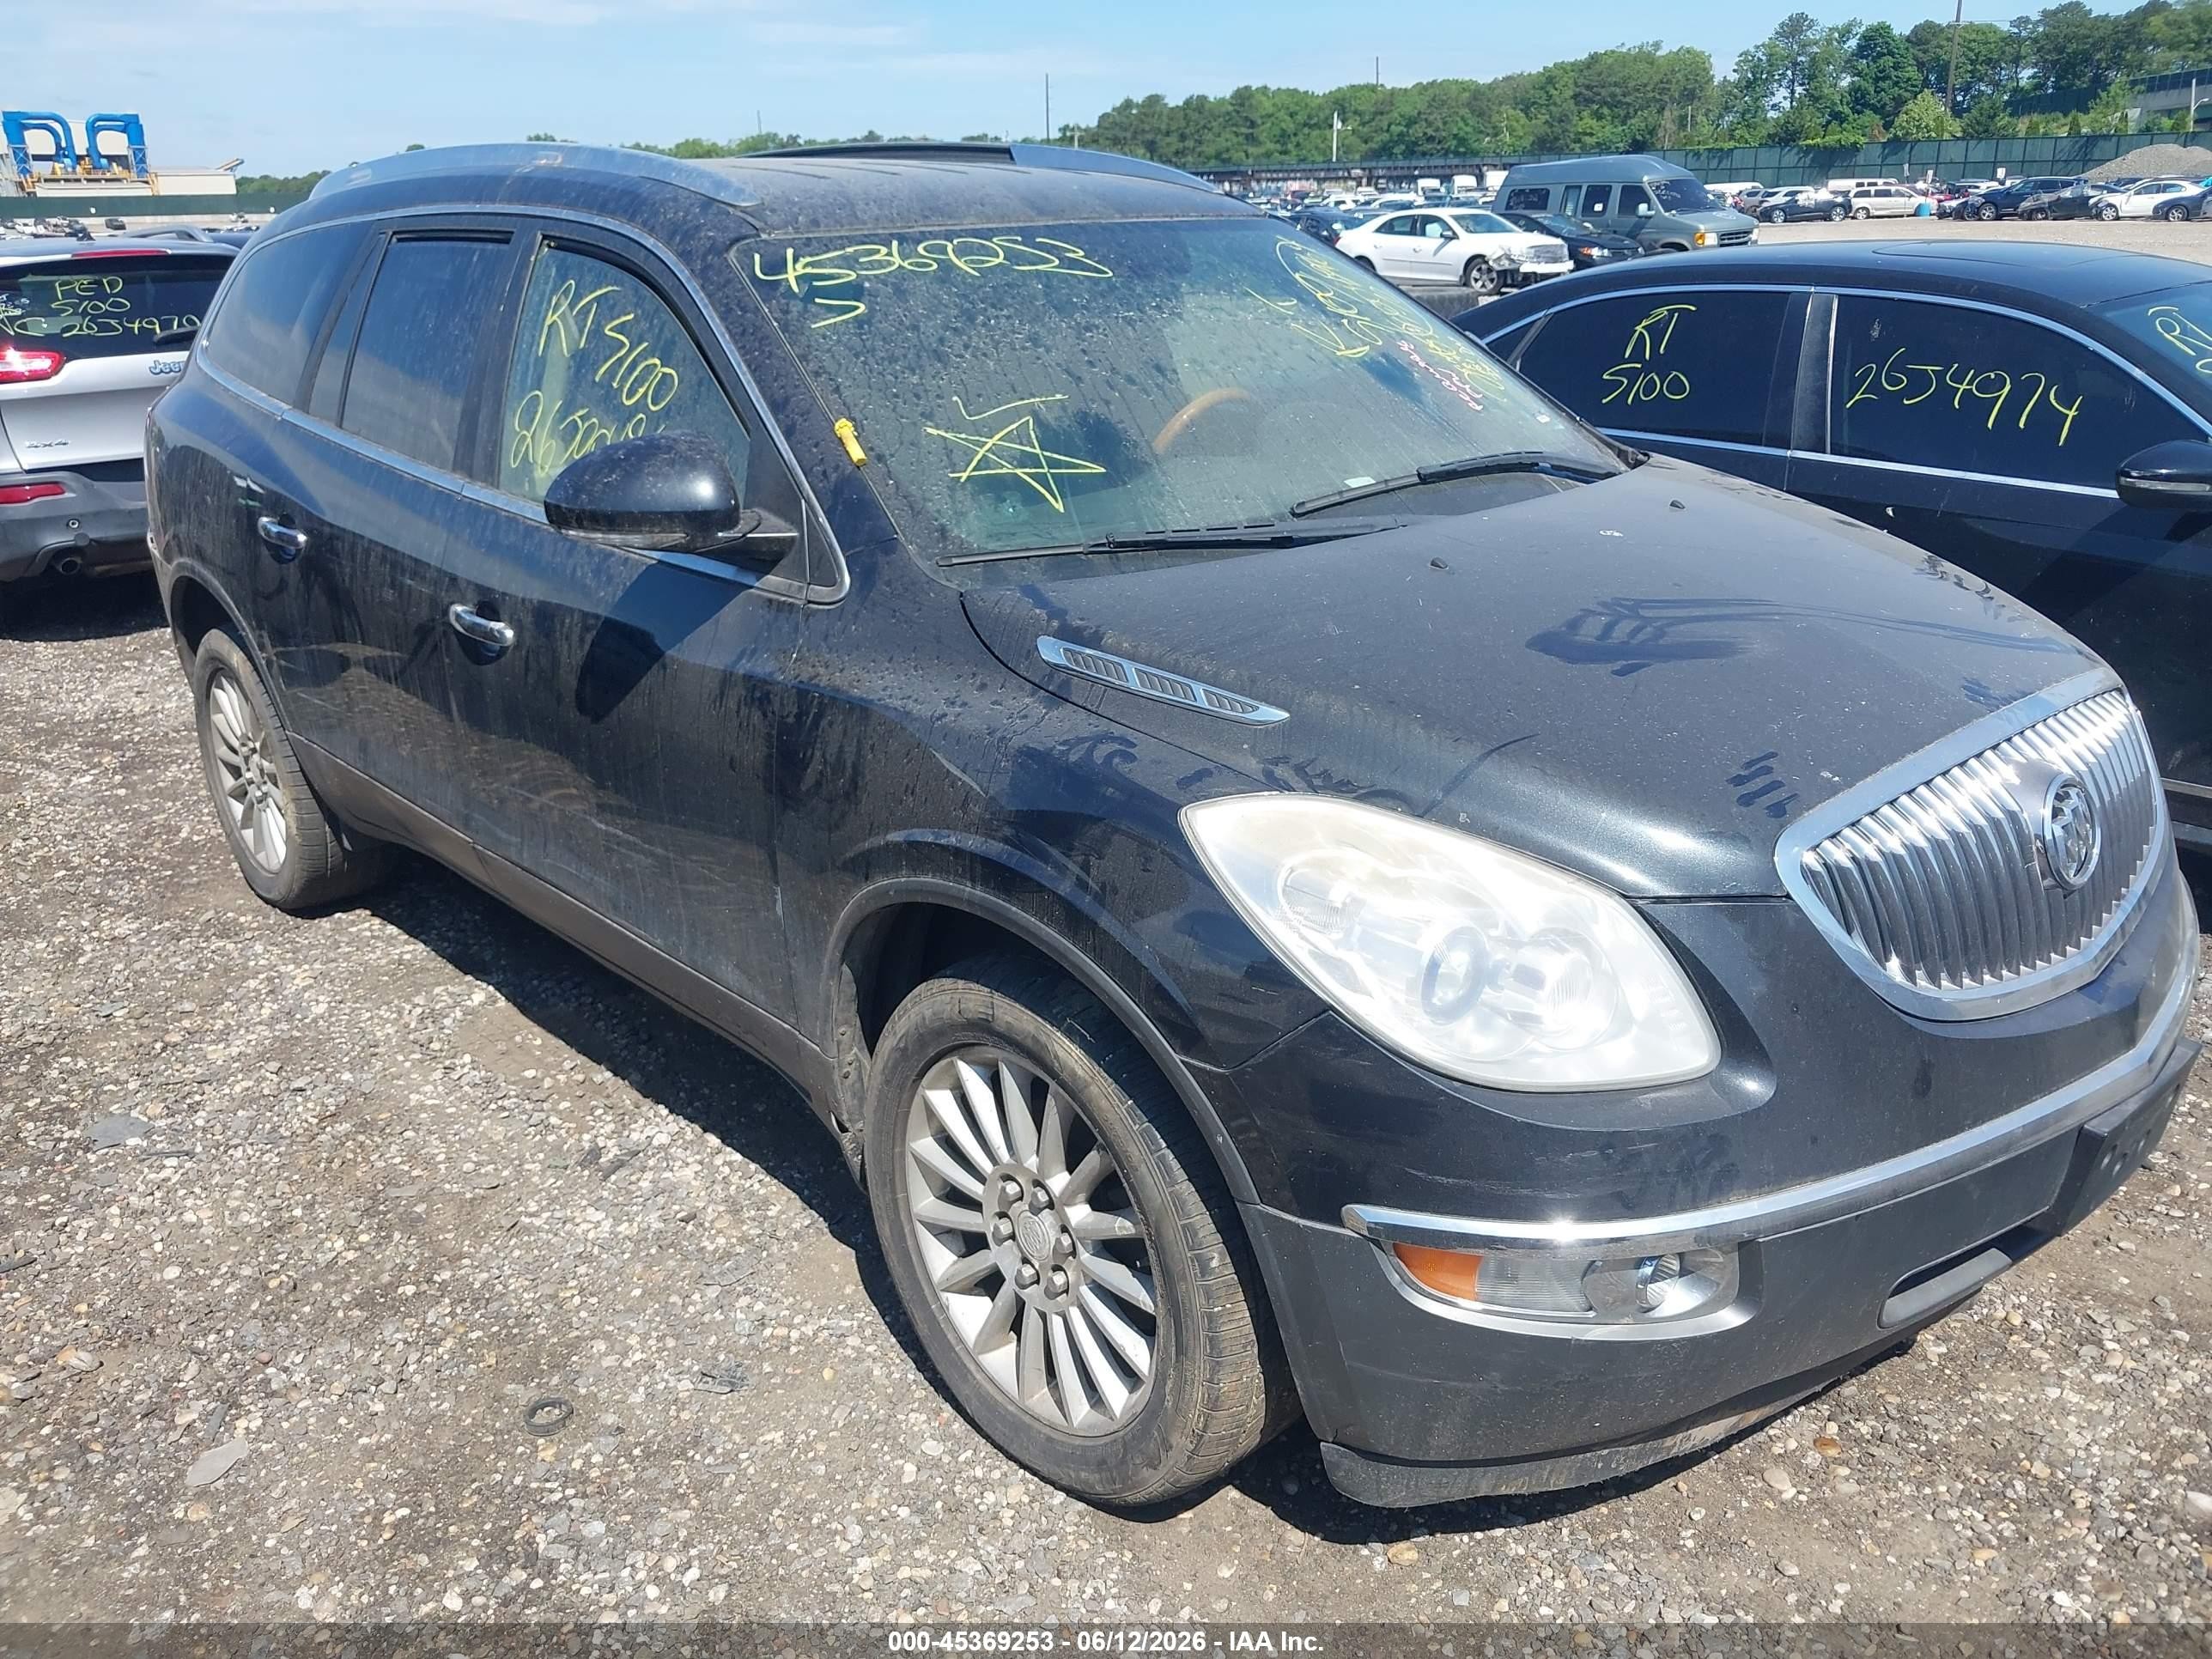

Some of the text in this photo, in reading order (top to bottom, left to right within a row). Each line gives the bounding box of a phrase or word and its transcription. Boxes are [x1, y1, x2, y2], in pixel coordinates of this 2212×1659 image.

[753, 236, 1114, 294] 45369253
[538, 279, 621, 357] RT
[1624, 304, 1697, 361] RT
